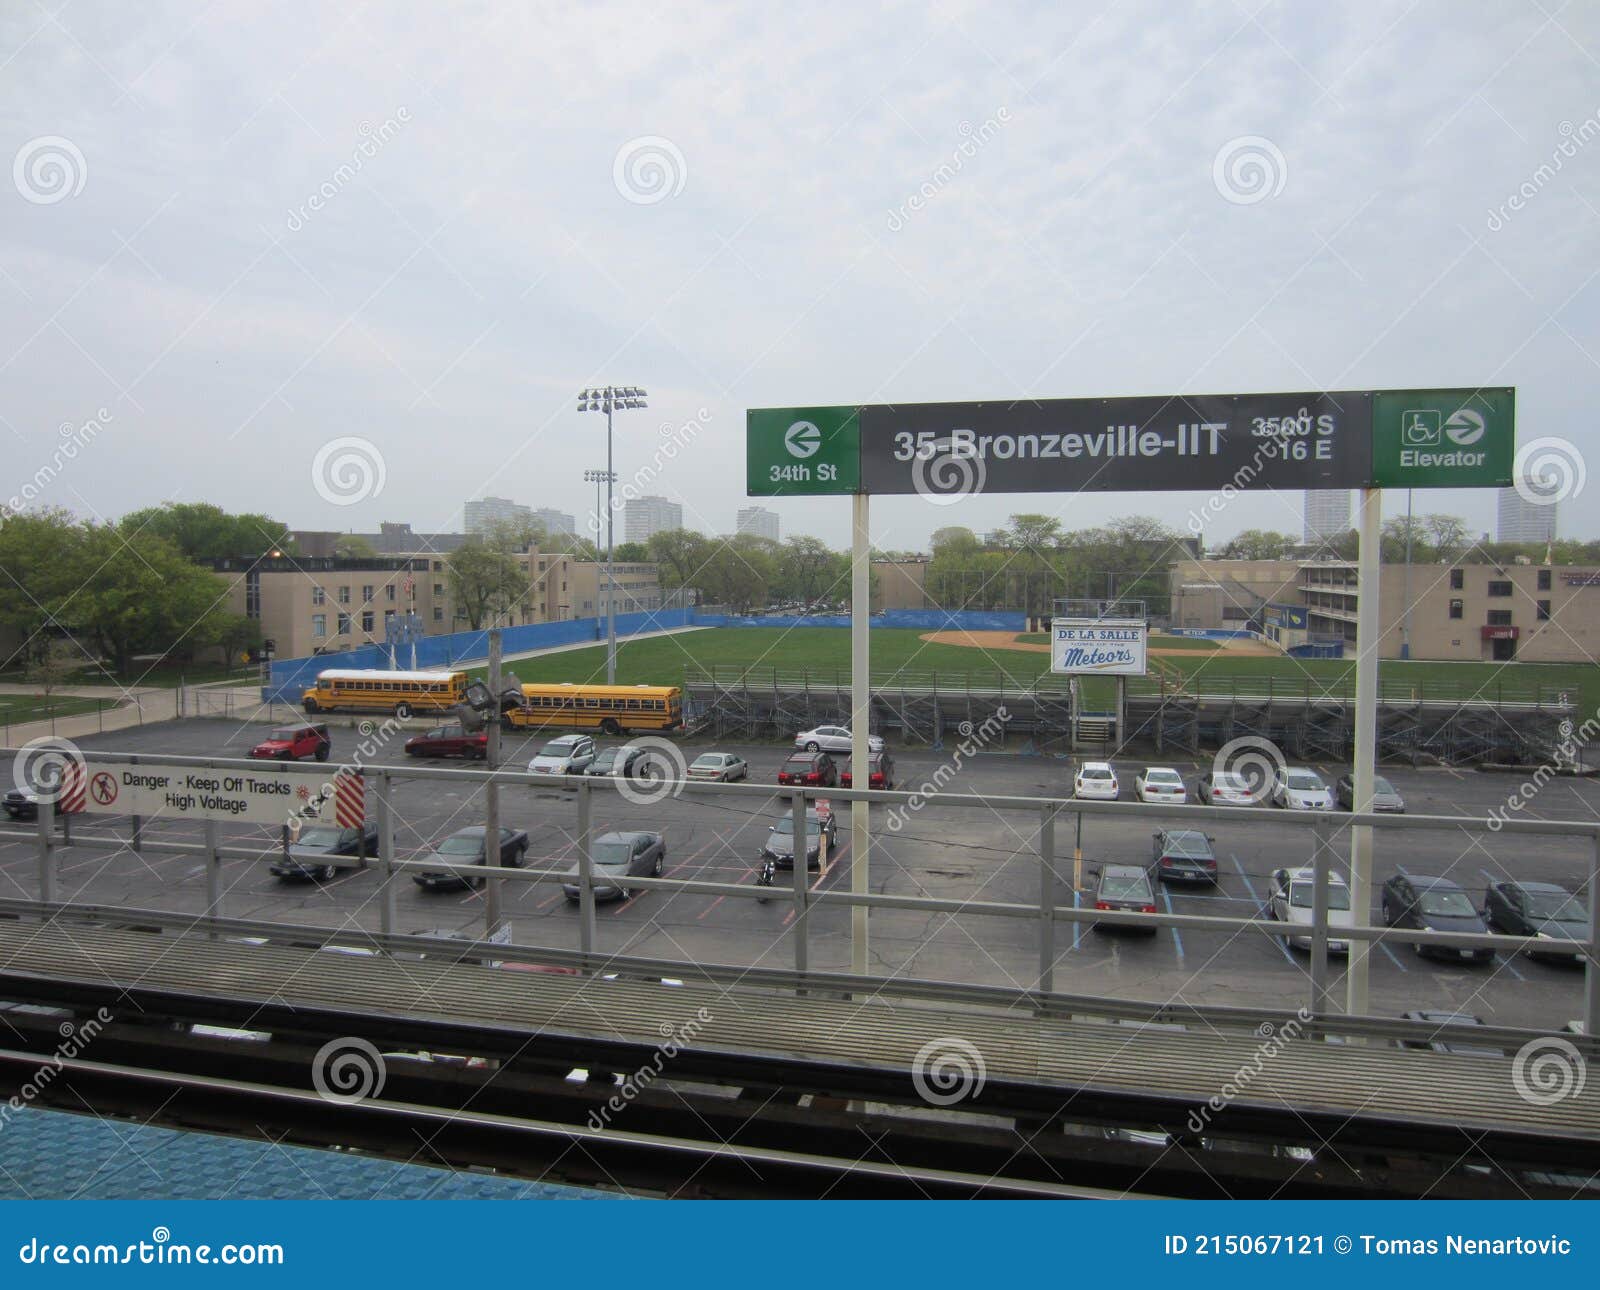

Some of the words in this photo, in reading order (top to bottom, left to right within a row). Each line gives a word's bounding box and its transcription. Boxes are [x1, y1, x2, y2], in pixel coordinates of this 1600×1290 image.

[1251, 416, 1311, 437] 3500
[1316, 414, 1334, 436] S
[893, 422, 1228, 462] 35-Bronzeville-IIT
[1279, 440, 1308, 460] 16
[1315, 439, 1332, 460] E
[1399, 449, 1486, 467] Elevator
[769, 463, 811, 482] 34th
[816, 463, 838, 481] St
[1058, 630, 1075, 639] DE
[1079, 630, 1095, 639] LA
[1100, 631, 1139, 640] SALLE
[1064, 648, 1132, 667] Meteors
[122, 771, 170, 790] Danger
[186, 775, 220, 793] Keep
[224, 777, 243, 792] Off
[247, 778, 291, 796] Tracks
[165, 792, 197, 810] High
[199, 793, 248, 813] Voltage
